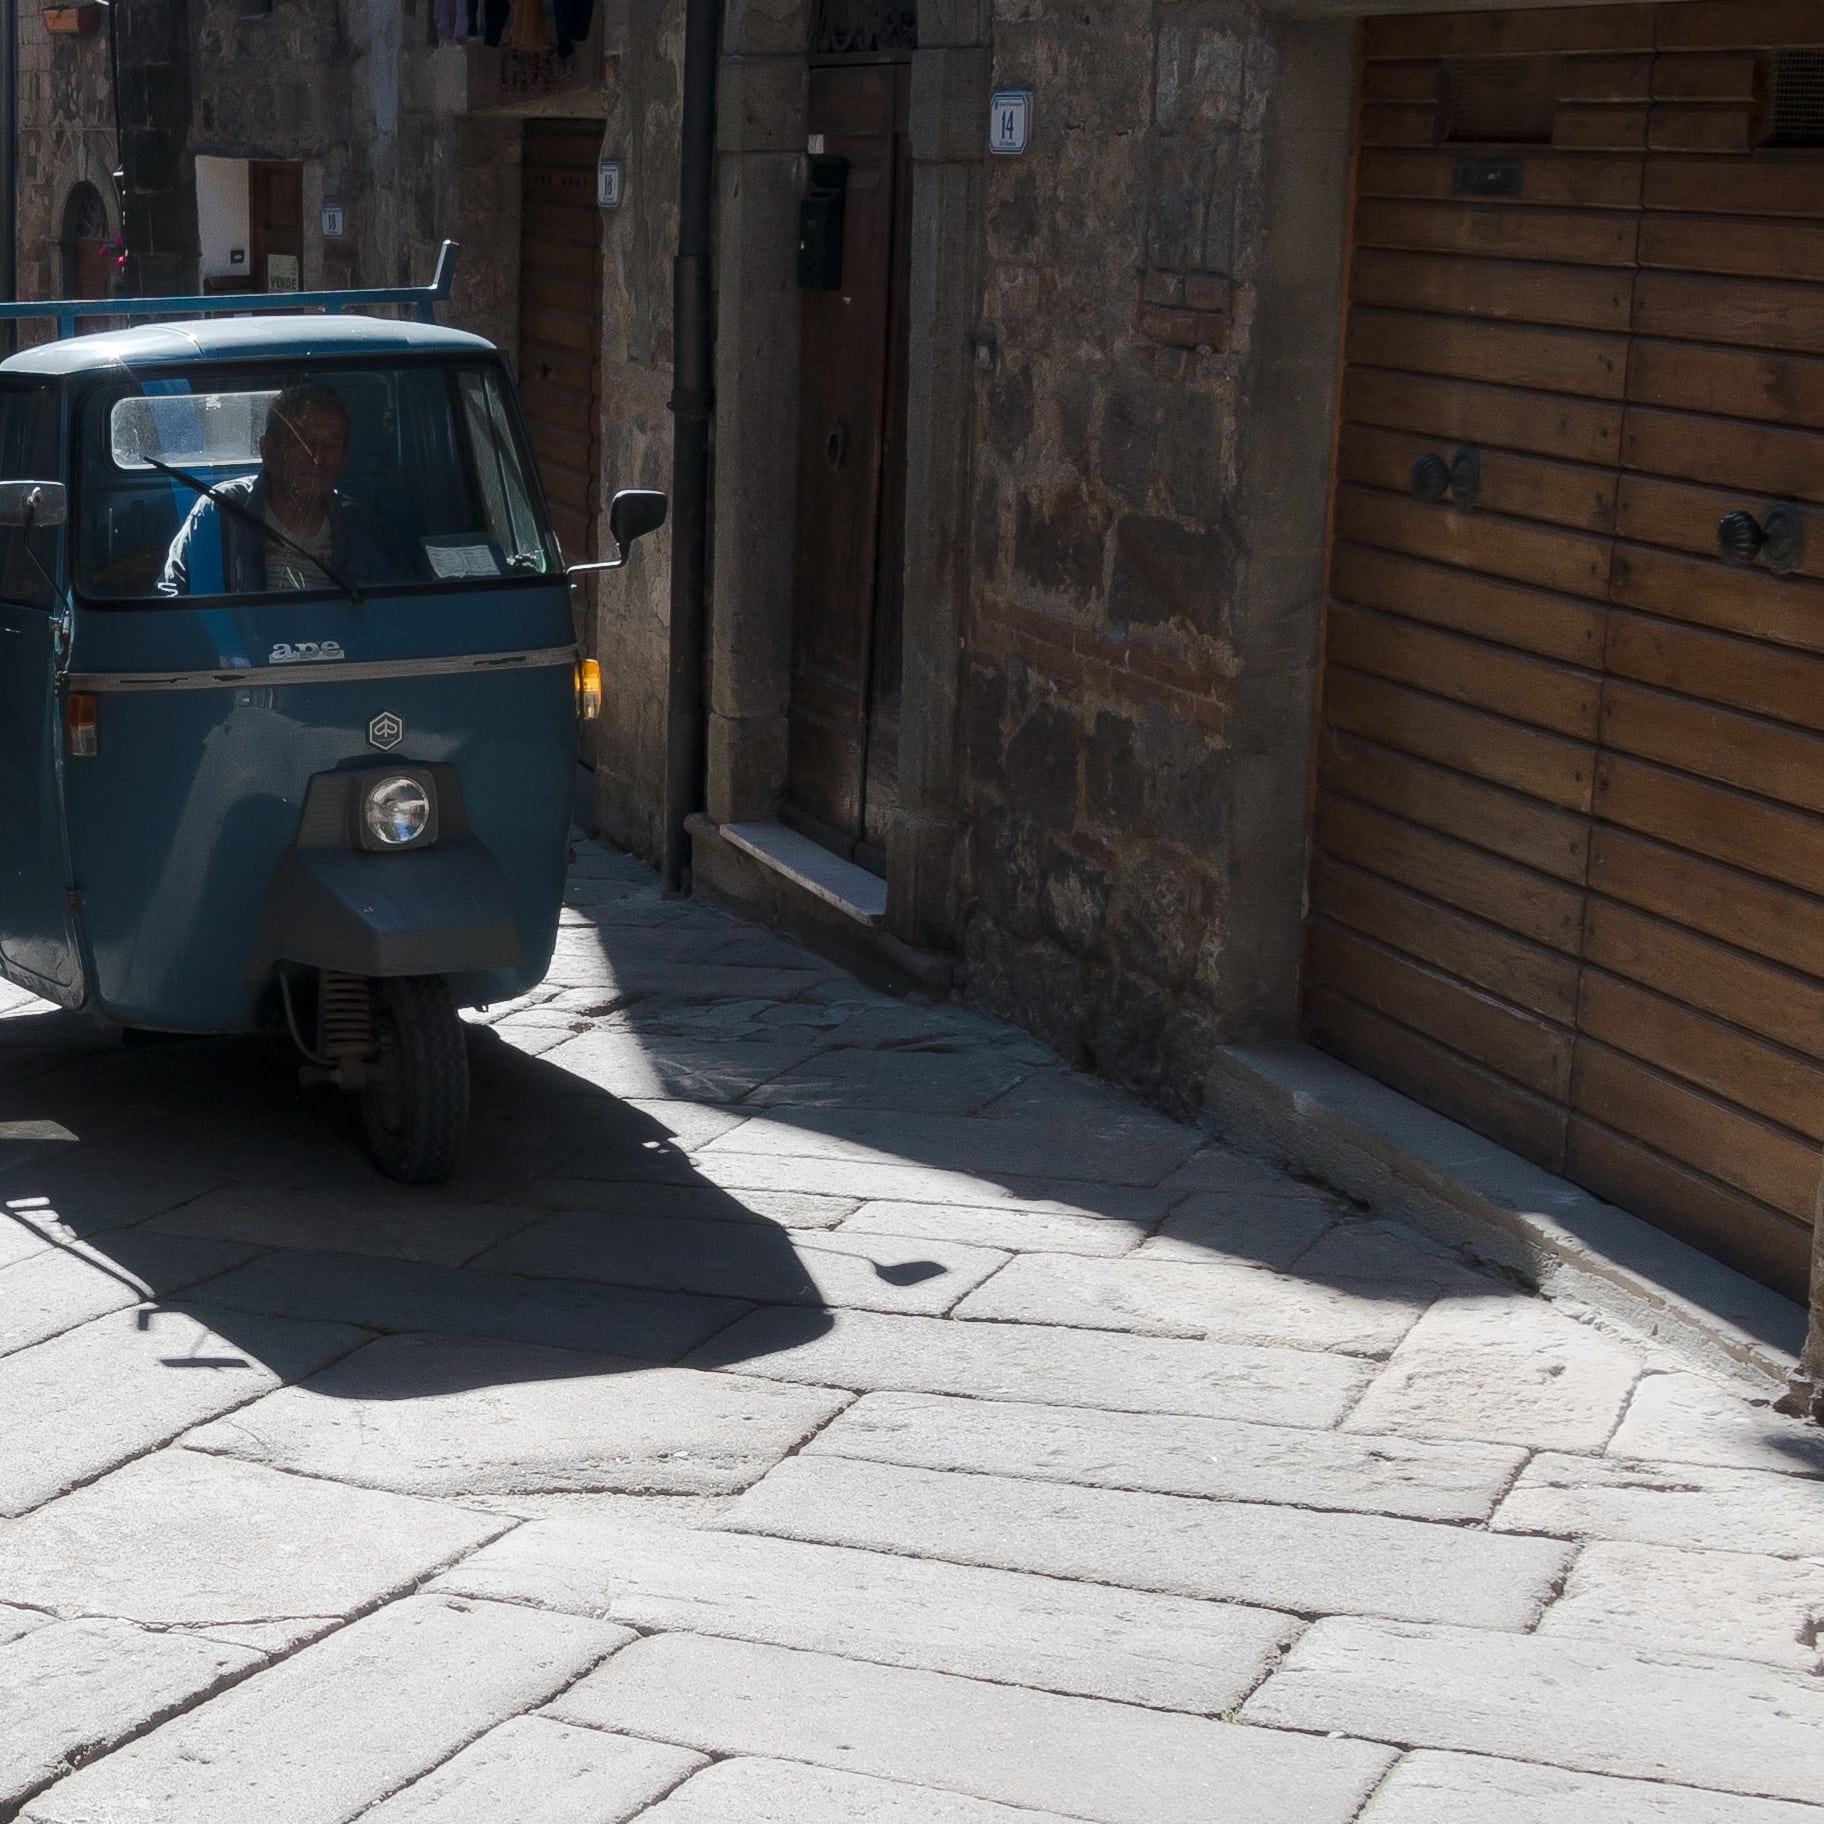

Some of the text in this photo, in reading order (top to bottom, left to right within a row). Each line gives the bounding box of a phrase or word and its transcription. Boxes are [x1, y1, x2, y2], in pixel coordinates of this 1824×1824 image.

[1001, 109, 1014, 139] 14
[270, 275, 297, 290] VENDE
[270, 640, 342, 661] ape
